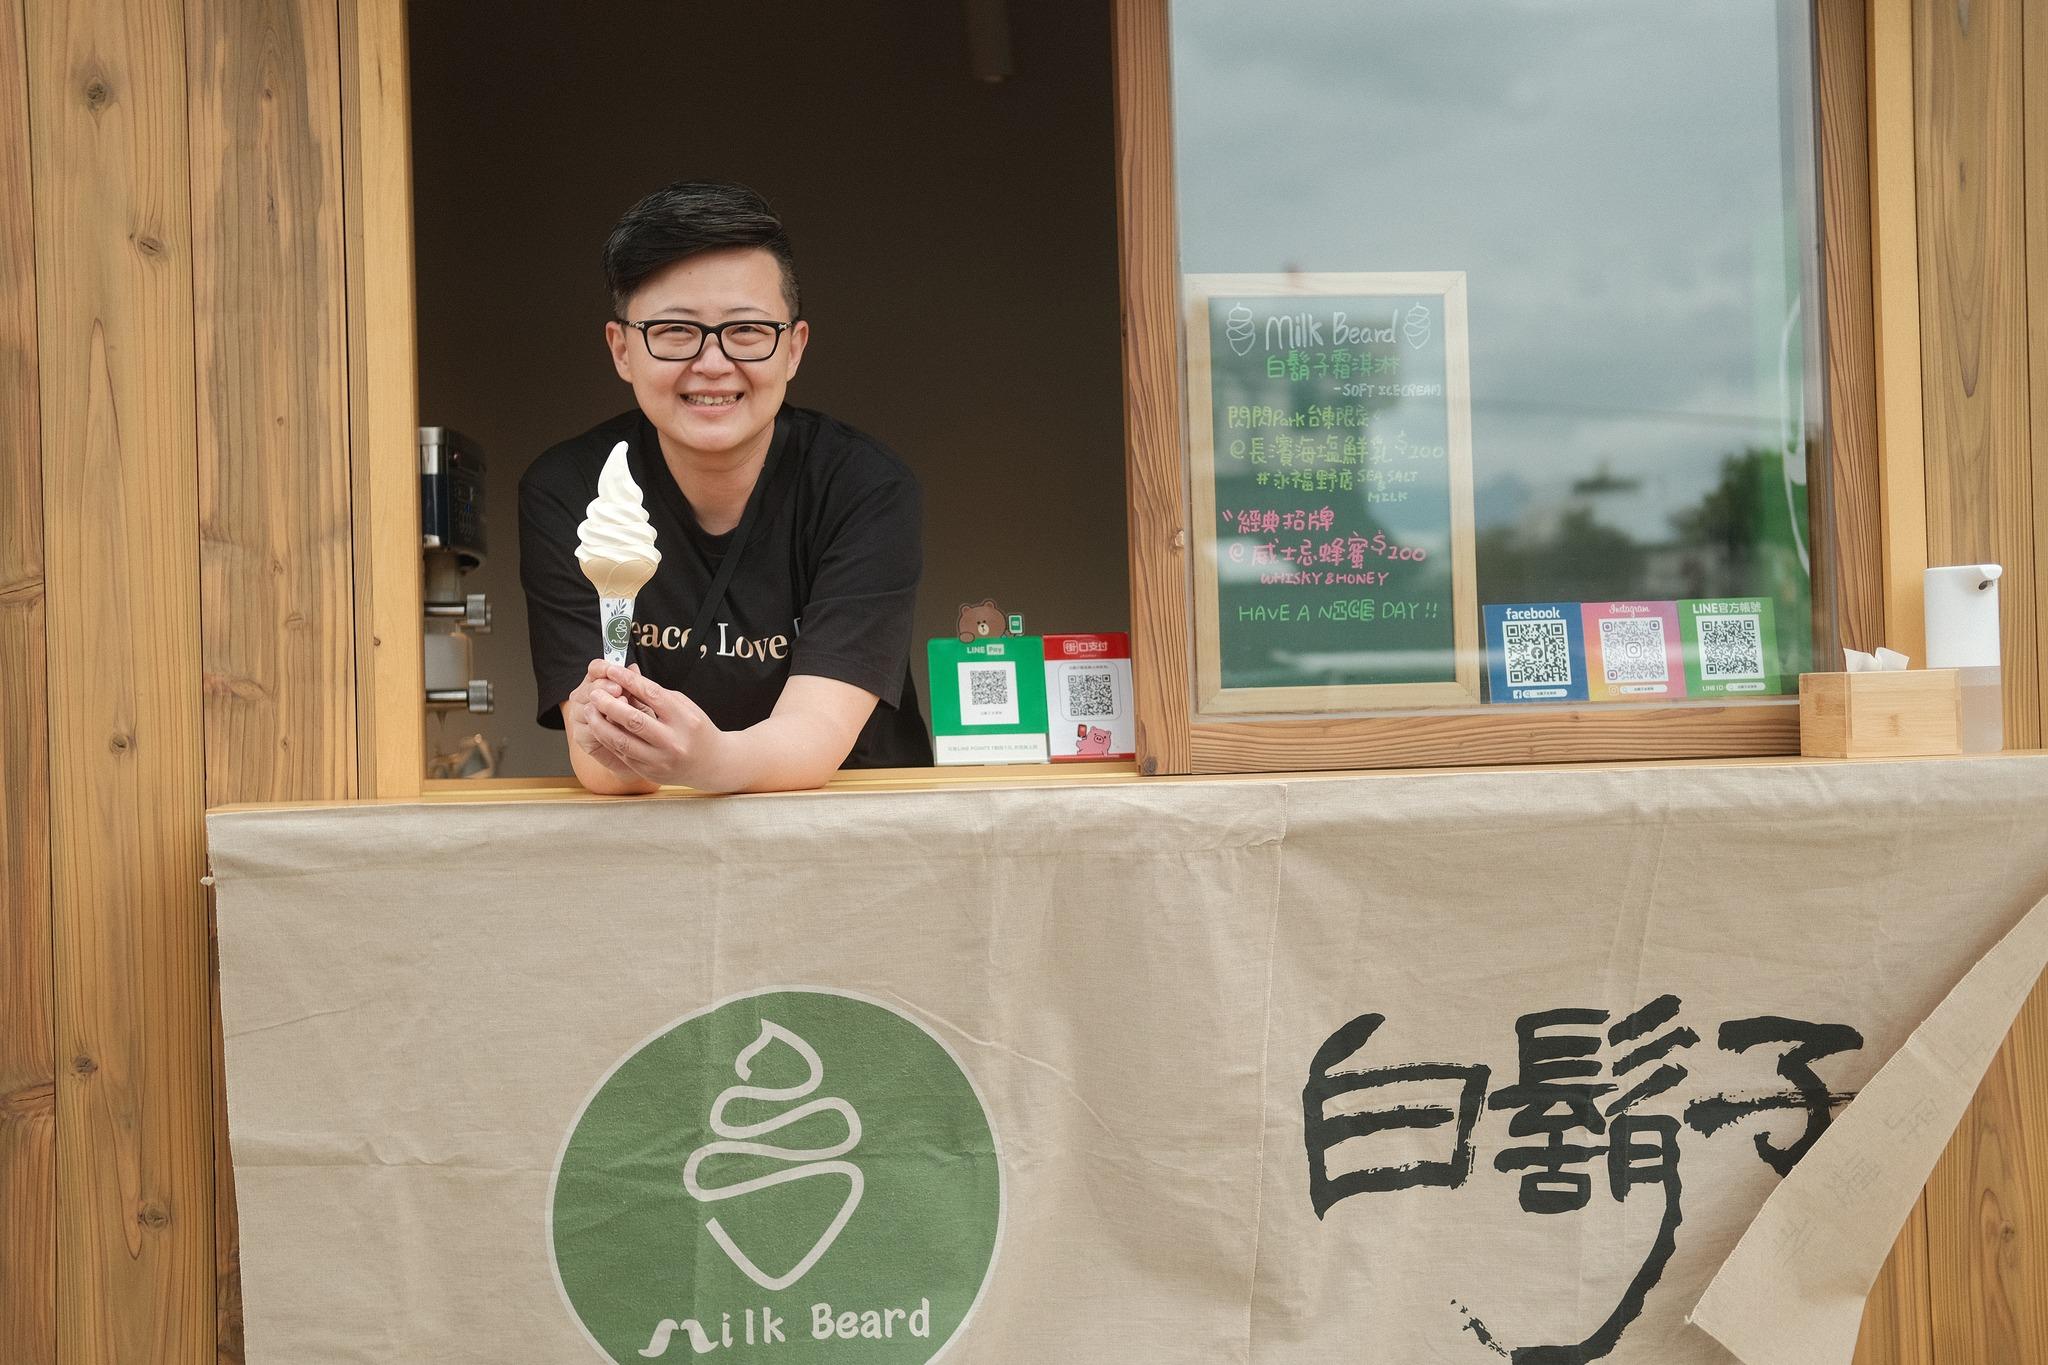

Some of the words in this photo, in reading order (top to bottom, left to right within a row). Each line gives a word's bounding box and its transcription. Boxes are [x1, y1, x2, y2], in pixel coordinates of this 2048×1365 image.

[1265, 312, 1324, 350] Milk
[1332, 309, 1399, 346] Beard
[1367, 491, 1408, 503] MILK
[1239, 604, 1290, 621] HAVE
[1296, 604, 1310, 621] A
[1318, 599, 1375, 621] NICE
[1382, 602, 1419, 619] DAY
[1506, 606, 1560, 619] facebook
[1608, 604, 1651, 617] Instagram
[716, 622, 788, 662] Love
[966, 646, 986, 654] LINE
[1302, 994, 1864, 1365] 白鬍子
[811, 1297, 929, 1340] Beard
